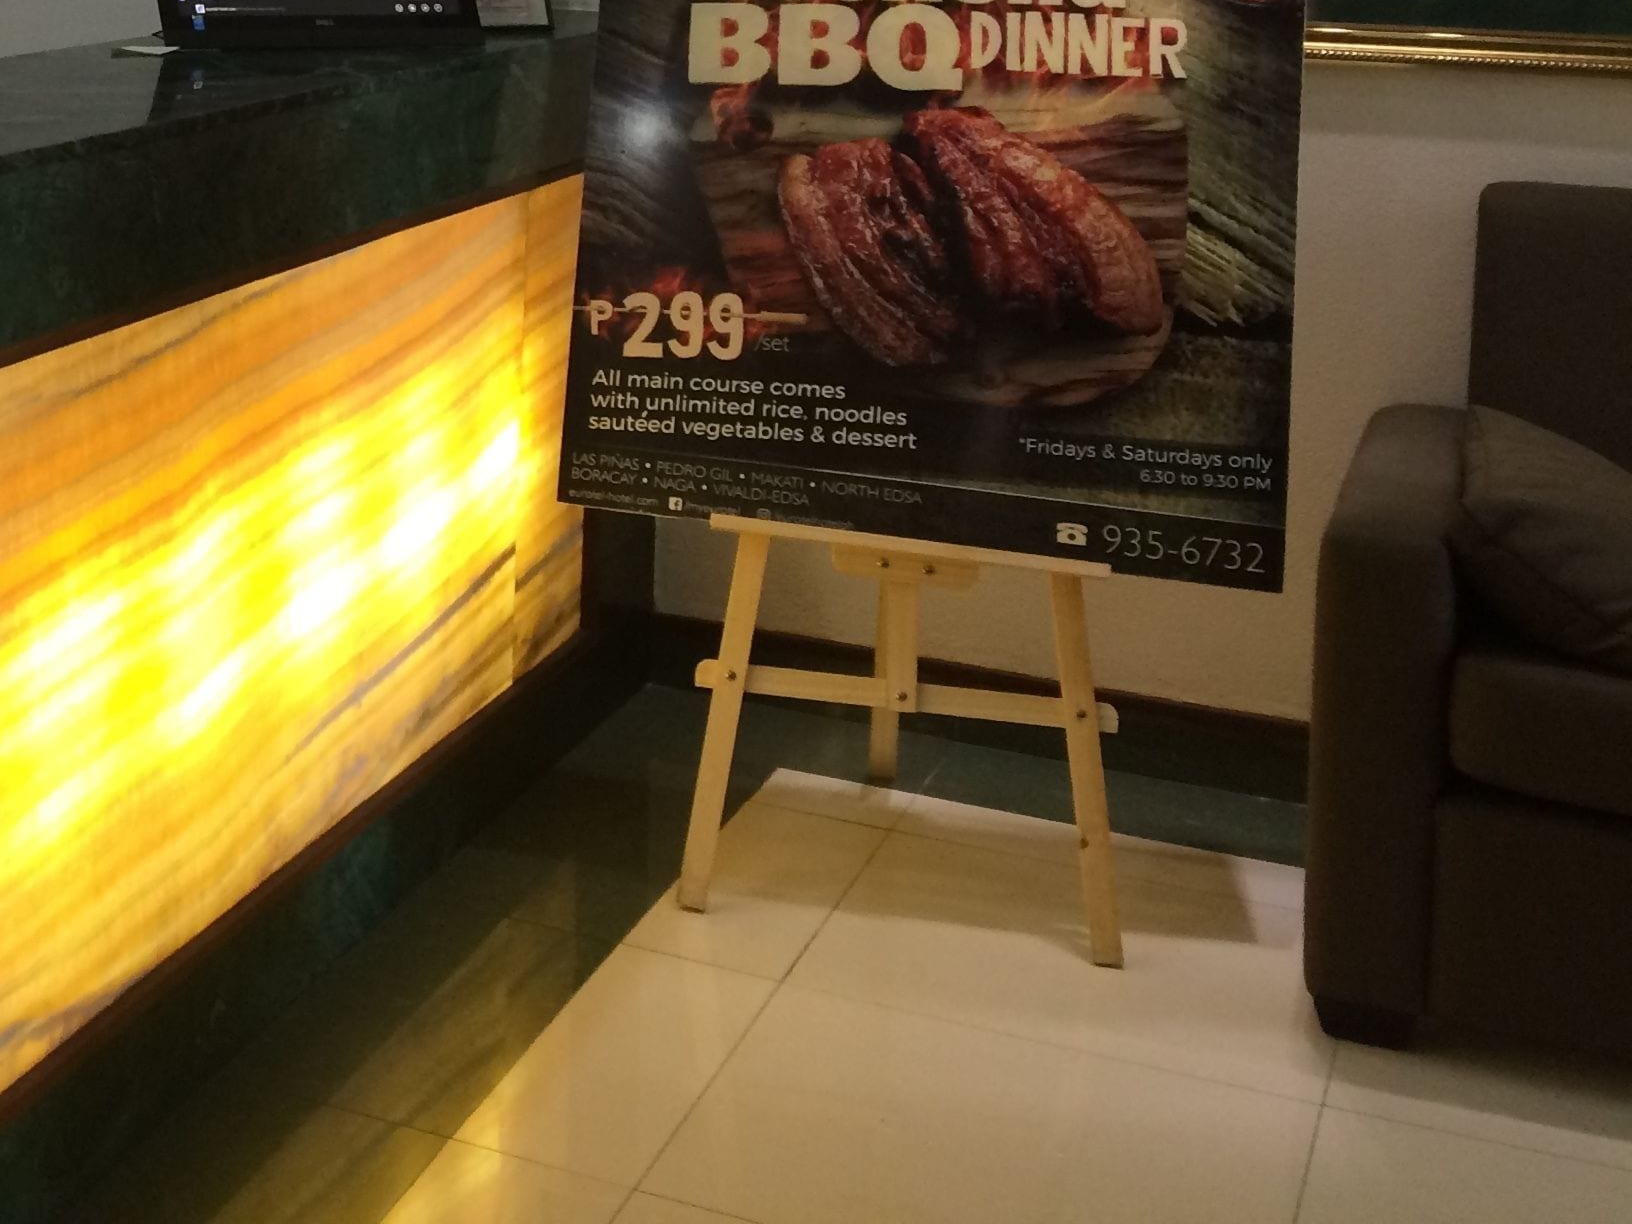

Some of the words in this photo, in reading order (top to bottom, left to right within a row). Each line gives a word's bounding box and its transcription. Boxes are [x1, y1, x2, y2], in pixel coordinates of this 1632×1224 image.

[688, 2, 963, 92] BBQ
[970, 10, 1188, 80] DINNER
[622, 291, 745, 361] 299
[754, 333, 790, 352] /set
[591, 369, 621, 387] All
[627, 372, 684, 390] main
[689, 377, 765, 394] course
[769, 380, 846, 399] comes
[590, 391, 639, 410] with
[646, 394, 755, 416] unlimited
[762, 400, 808, 421] rice,
[815, 405, 908, 426] noodles
[588, 410, 676, 434] sautéed
[682, 421, 805, 442] vegetables
[810, 426, 826, 443] &
[831, 427, 918, 450] dessert
[1102, 444, 1116, 460] &
[1121, 445, 1223, 470] Saturdays
[1228, 453, 1273, 474] only
[571, 466, 637, 486] BORACAY
[654, 476, 697, 493] NAGA
[572, 452, 596, 467] LAS
[656, 461, 706, 479] PEDRO
[709, 467, 733, 482] GIL
[751, 471, 804, 490] MAKATI
[821, 480, 880, 499] NORTH
[883, 488, 923, 504] EDSA
[1181, 474, 1198, 486] to
[1243, 476, 1272, 491] PM
[1101, 524, 1266, 574] 935-6732
